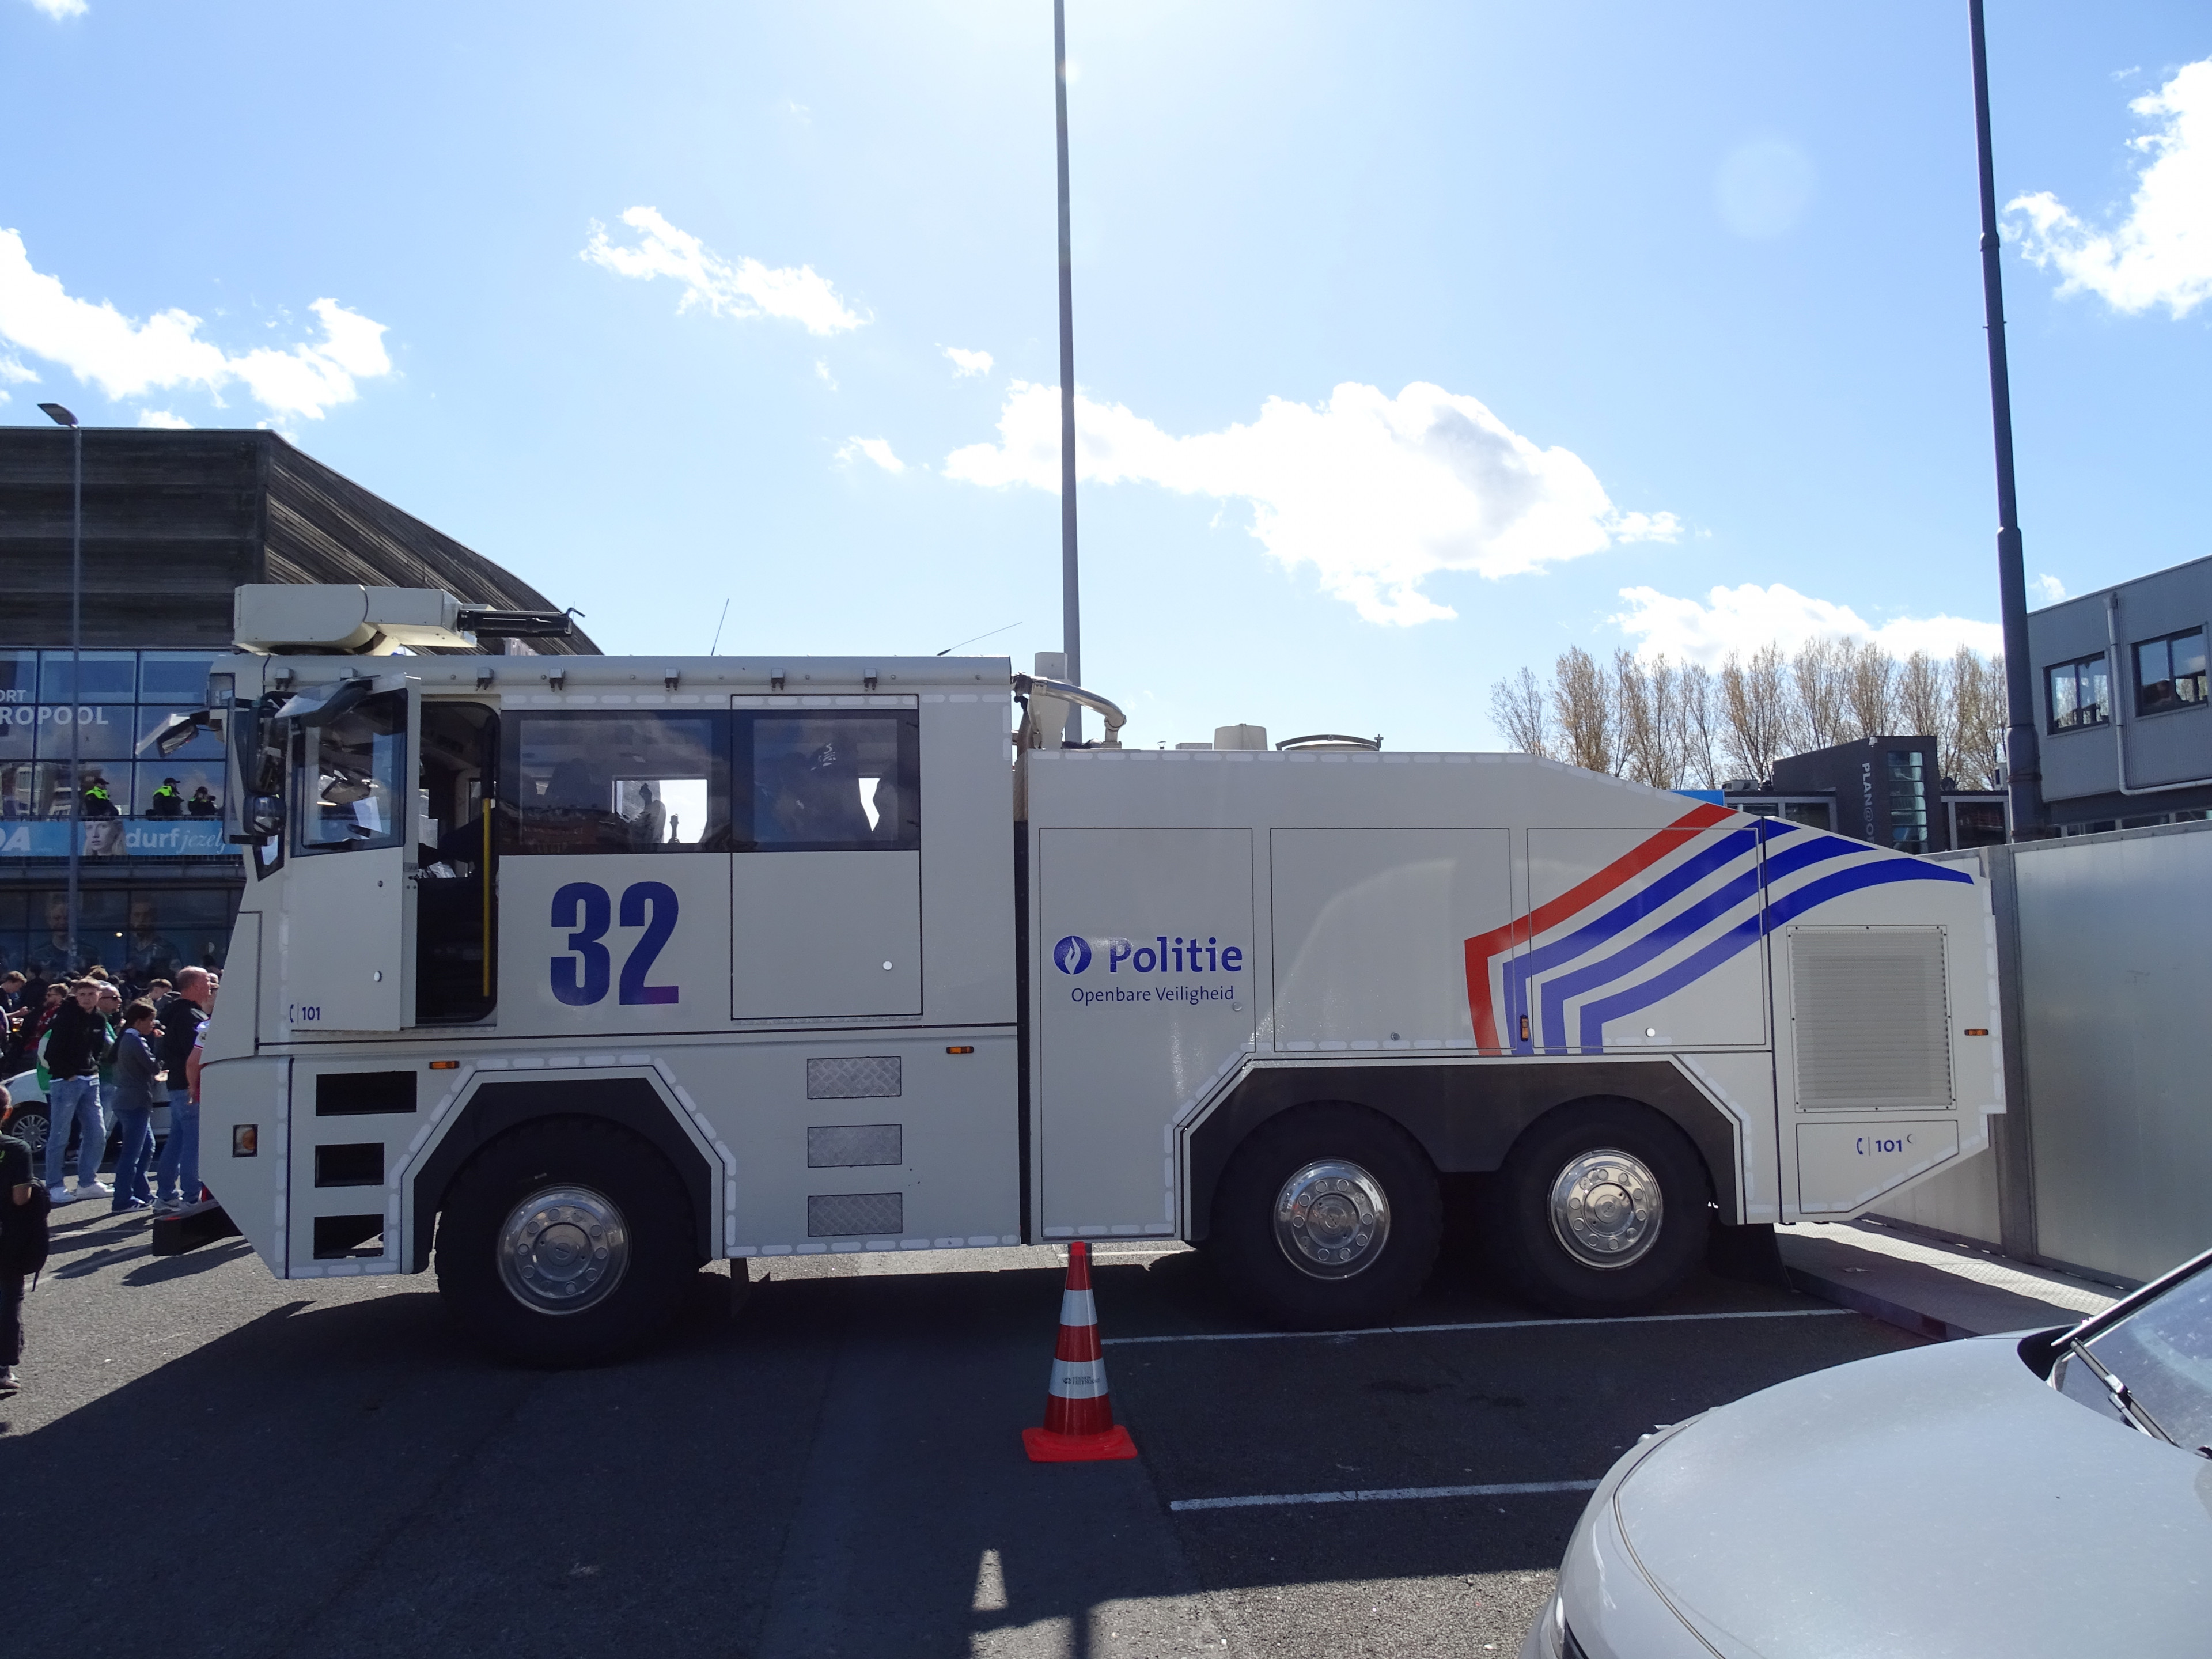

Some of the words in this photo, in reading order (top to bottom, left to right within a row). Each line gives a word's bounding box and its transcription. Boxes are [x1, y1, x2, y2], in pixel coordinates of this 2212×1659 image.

[0, 706, 109, 725] ROPOOL
[126, 828, 180, 848] durf
[550, 881, 679, 1006] 32
[1109, 936, 1243, 973] Politie
[1071, 987, 1152, 1006] Openbare
[1155, 985, 1234, 1005] Veiligheid
[302, 1006, 320, 1021] 101
[1875, 1139, 1902, 1152] 101
